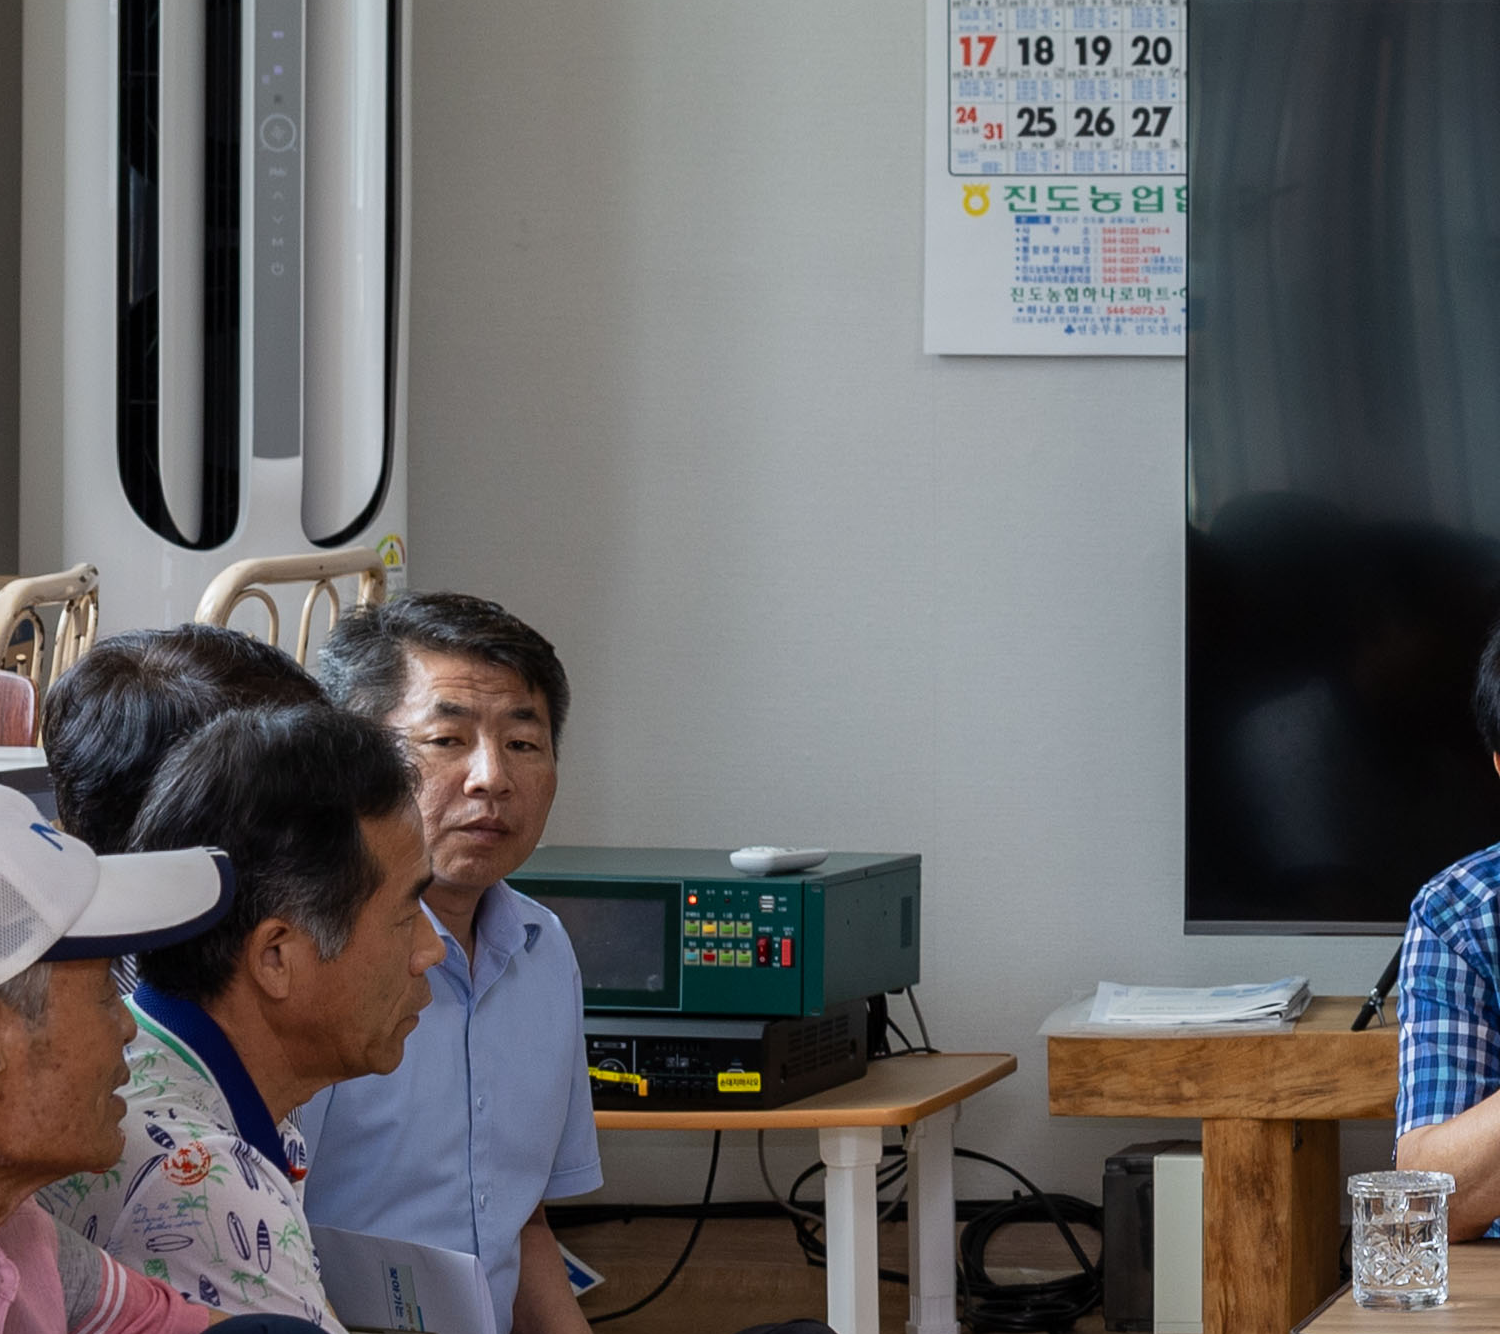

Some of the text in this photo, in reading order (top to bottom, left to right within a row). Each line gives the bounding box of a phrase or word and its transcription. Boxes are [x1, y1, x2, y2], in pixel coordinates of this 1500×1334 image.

[959, 35, 1173, 67] 17 18 19 20
[955, 105, 1173, 140] 24 31 25 26 27
